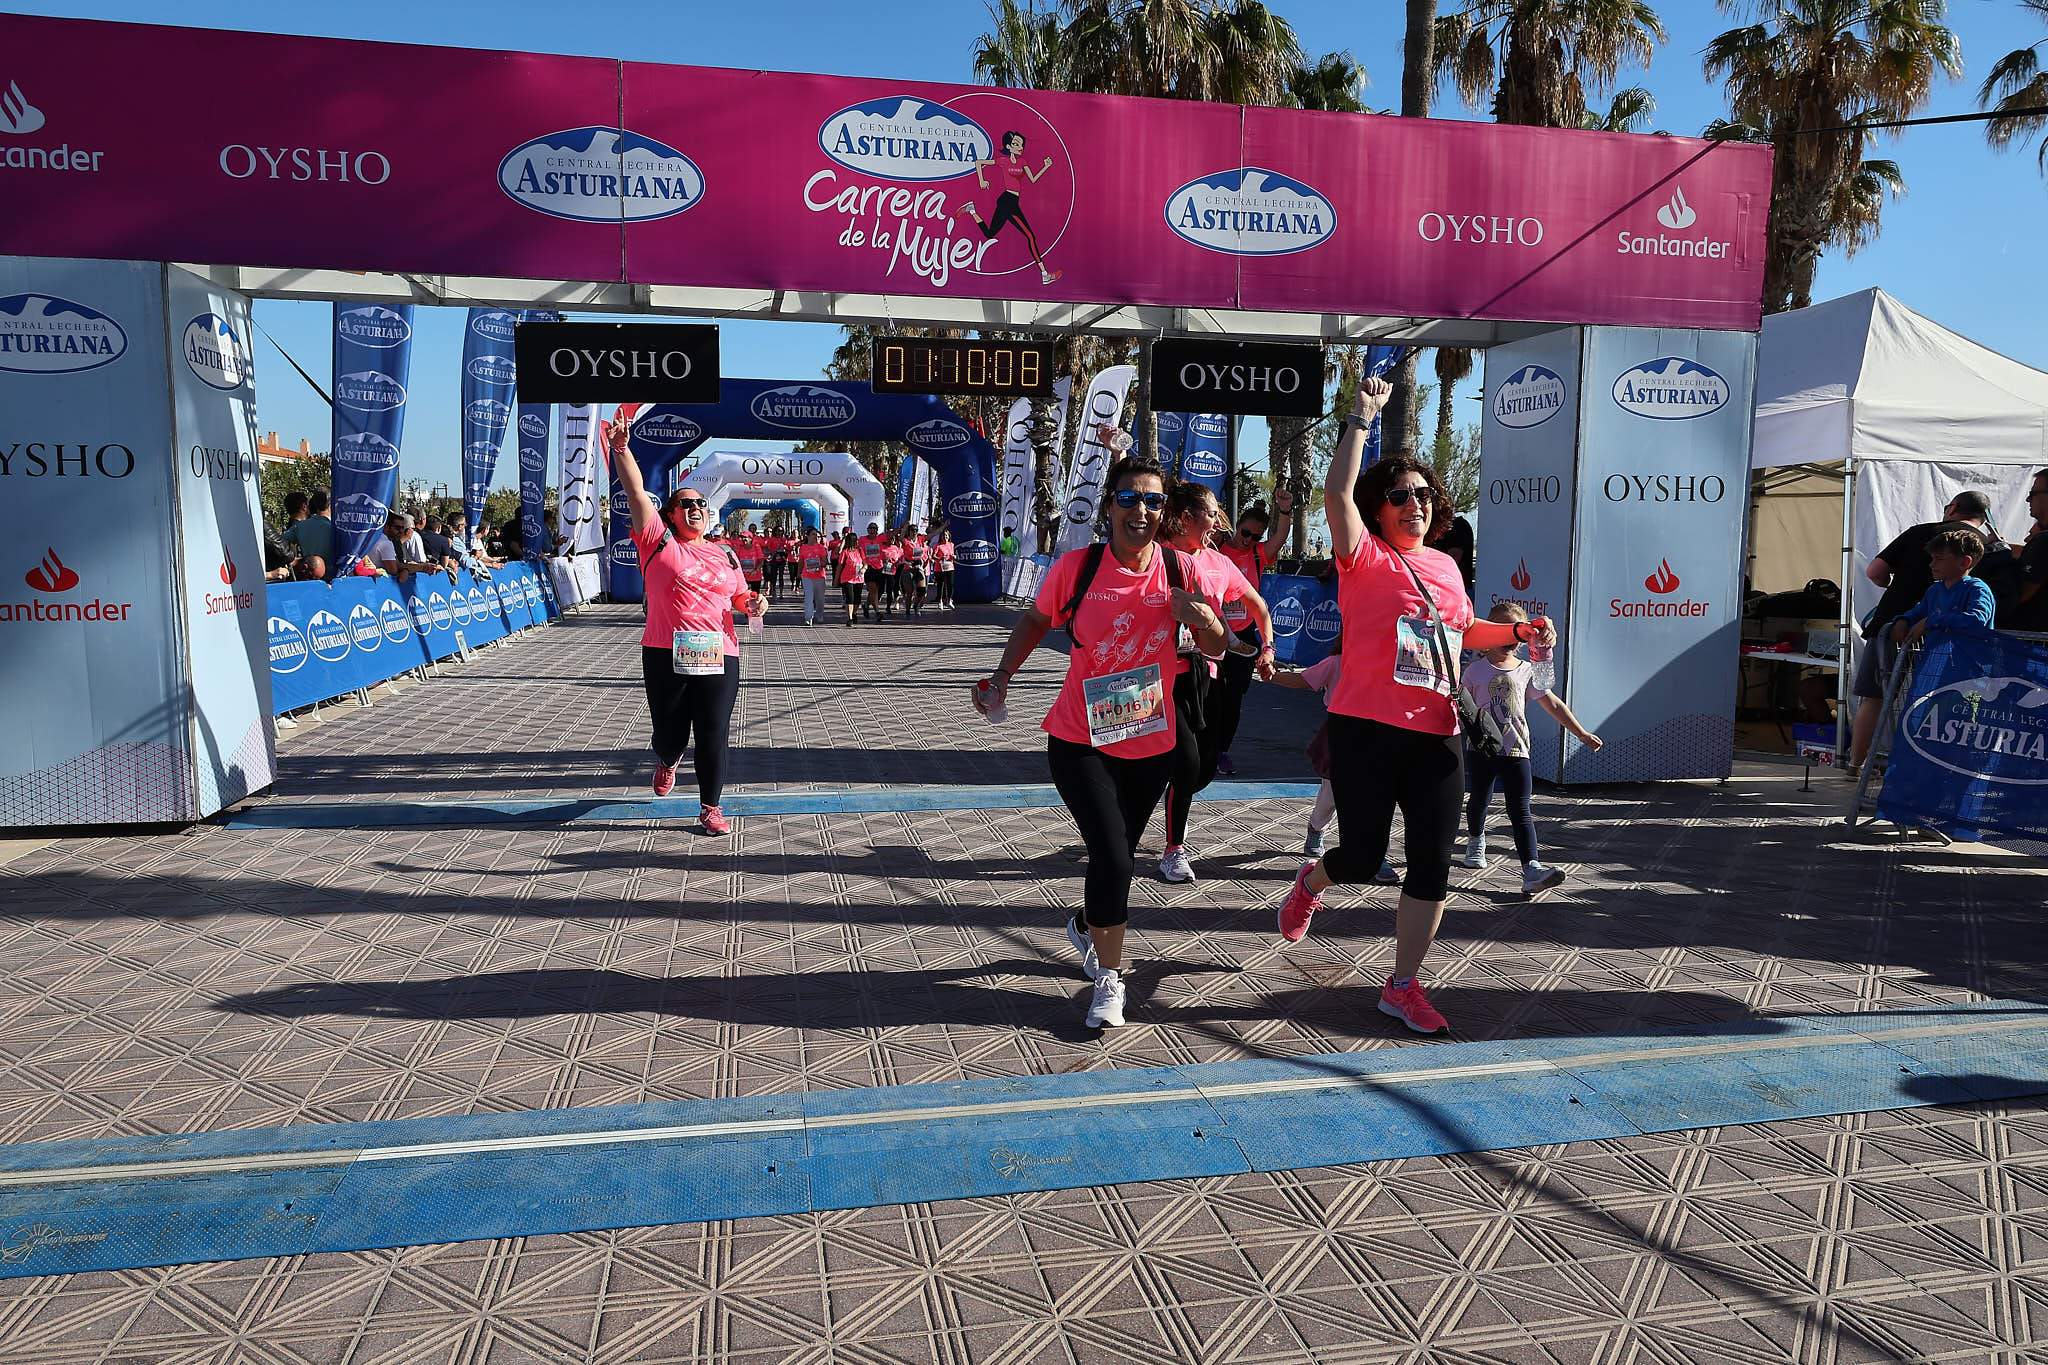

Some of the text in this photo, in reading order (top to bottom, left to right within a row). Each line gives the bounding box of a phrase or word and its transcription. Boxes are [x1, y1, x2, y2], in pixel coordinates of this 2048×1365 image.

[832, 122, 979, 163] ASTURIANA
[859, 122, 975, 138] CENTRAL LECHERA
[219, 144, 391, 185] OYSHO
[547, 157, 611, 170] CENTRAL
[514, 157, 690, 201] ASTURIANA
[803, 169, 947, 219] Carrera
[1205, 196, 1319, 210] CENTRAL LECHERA
[1178, 196, 1323, 235] ASTURIANA
[1417, 212, 1544, 246] OYSHO
[838, 217, 999, 288] de la Mujer
[1617, 231, 1730, 259] Santander
[4, 321, 108, 332] NTRAL LECHERA
[342, 317, 404, 340] ASTURIANA
[0, 331, 115, 355] TURIANA
[189, 333, 244, 377] ASTURIANA
[472, 362, 516, 381] ASTURIAN
[549, 348, 692, 380] OYSHO
[886, 347, 1039, 386] 01:10:08
[1180, 363, 1300, 394] OYSHO
[1639, 378, 1718, 387] CENTRAL LECHERA
[1497, 391, 1560, 417] ASTURIANA
[1620, 379, 1721, 405] ASTURIANA
[759, 398, 849, 419] ASTURIANA
[638, 424, 696, 438] ASTURIANA
[911, 431, 967, 443] ASTURIANA
[0, 443, 135, 479] YSHO
[191, 445, 252, 483] OYSHO
[741, 458, 824, 476] OYSHO
[1066, 389, 1120, 525] OYSHO
[1490, 475, 1561, 505] OYSHO
[1603, 474, 1726, 503] OYSHO
[951, 502, 995, 513] ASTURIANA
[205, 591, 253, 616] Santander
[1086, 591, 1119, 602] OYSHO
[1609, 598, 1710, 618] Santander
[0, 598, 132, 622] antander
[269, 640, 306, 661] STURIANA
[1951, 702, 2015, 723] CETRAL
[1913, 703, 2048, 761] ASTURIA
